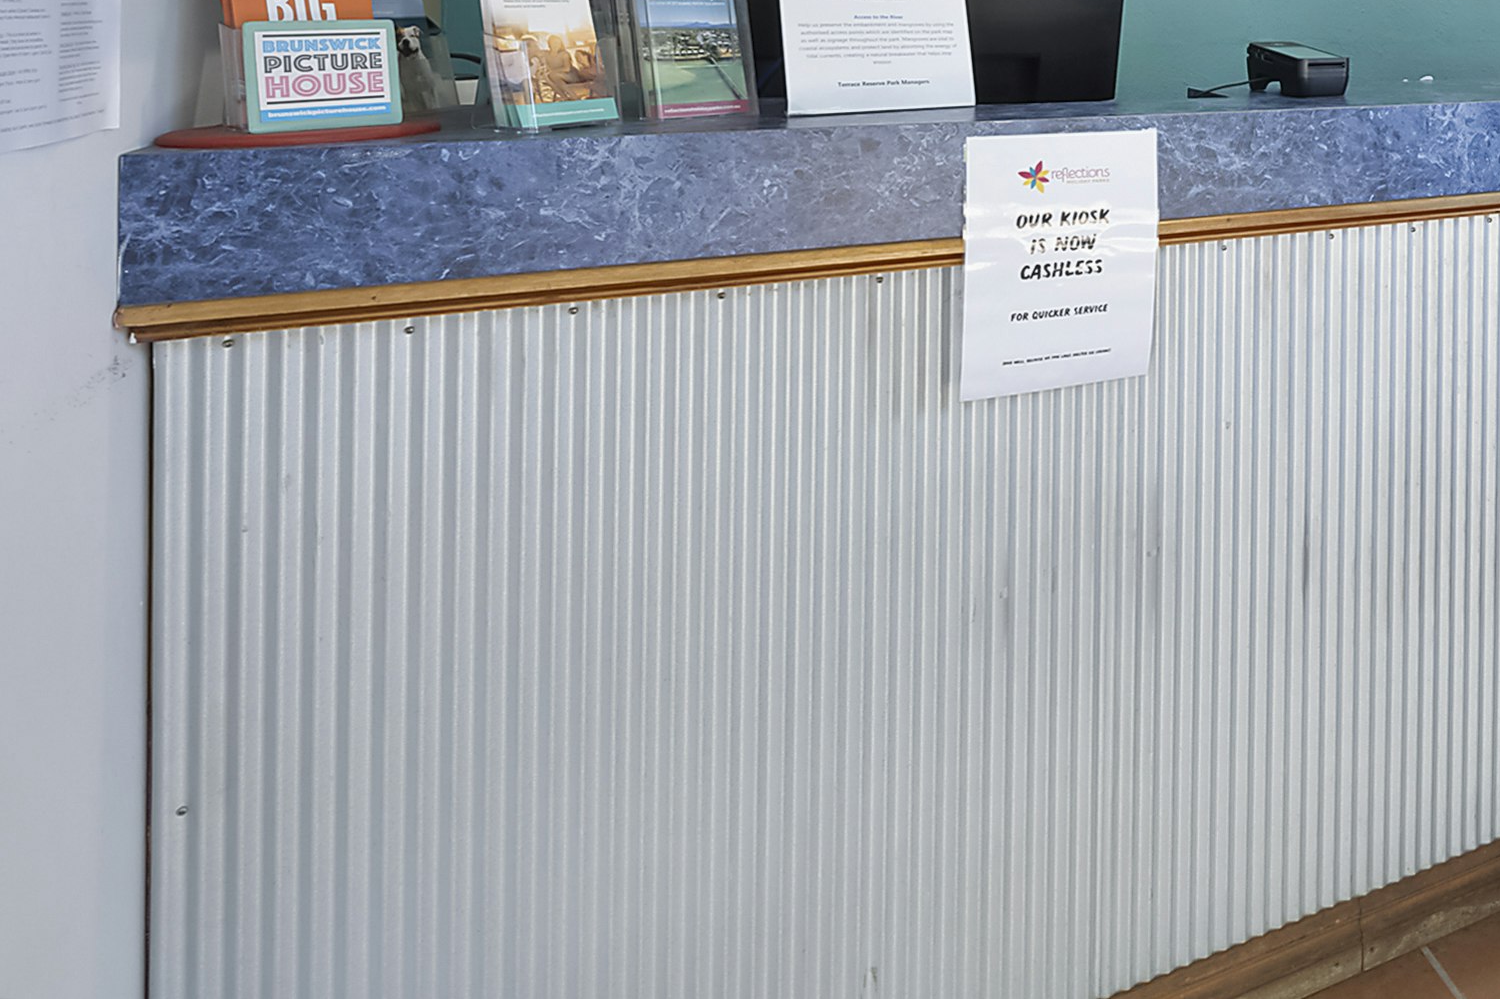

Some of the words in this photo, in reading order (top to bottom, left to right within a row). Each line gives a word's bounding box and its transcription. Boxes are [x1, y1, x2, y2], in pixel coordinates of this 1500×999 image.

[262, 37, 381, 54] BRUNSWICK
[263, 52, 383, 73] PICTURE
[265, 71, 384, 99] HOUSE
[268, 105, 386, 119] brunswickpicturehouse.com
[1051, 165, 1110, 183] reflections
[1016, 212, 1053, 229] OUR
[1059, 208, 1110, 226] KIOSK
[1030, 238, 1046, 254] IS
[1054, 233, 1096, 252] NOW
[1020, 259, 1103, 281] CASHLESS
[1010, 312, 1028, 322] FOR
[1032, 307, 1070, 320] QUICKER
[1074, 303, 1108, 316] SERVICE
